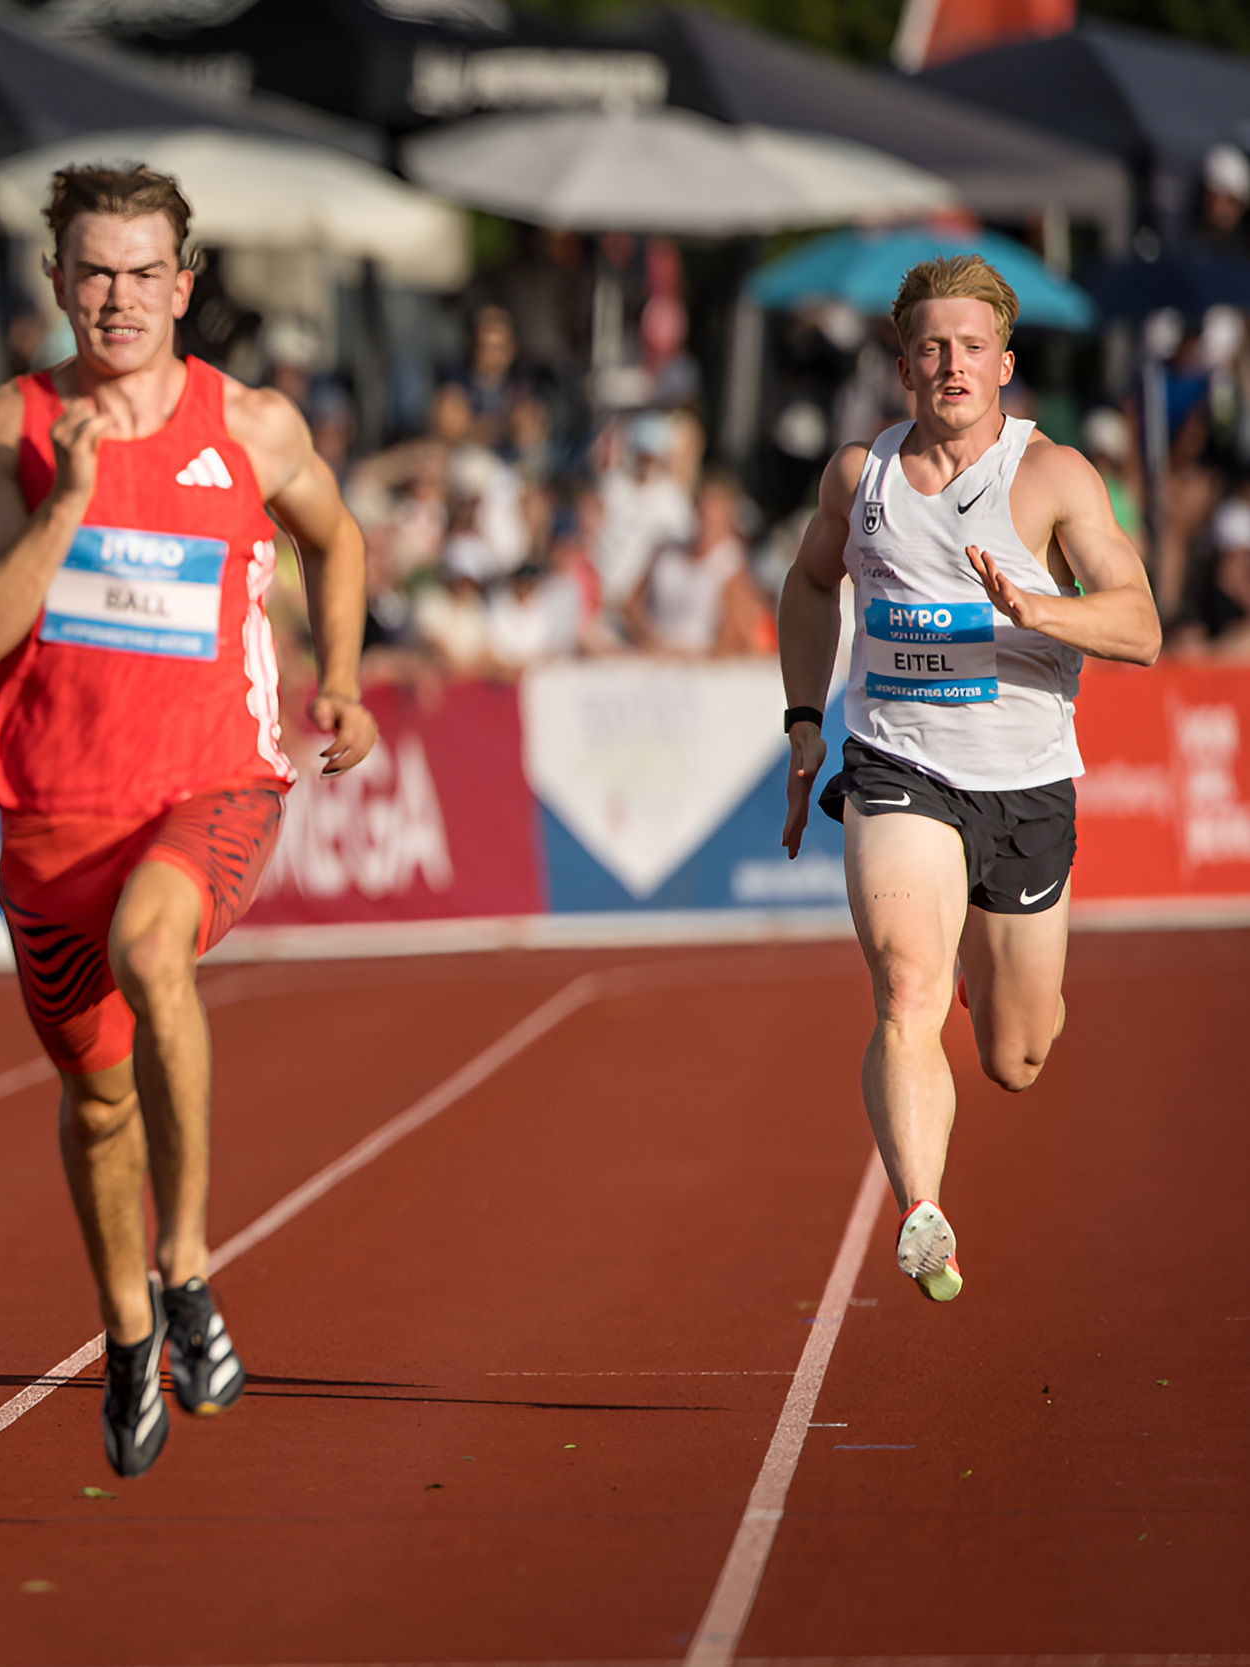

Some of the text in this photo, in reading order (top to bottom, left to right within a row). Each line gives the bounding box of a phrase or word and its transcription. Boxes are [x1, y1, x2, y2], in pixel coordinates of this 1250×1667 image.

[104, 586, 170, 617] BALL
[889, 608, 952, 628] HYPO
[894, 652, 954, 672] EITEL
